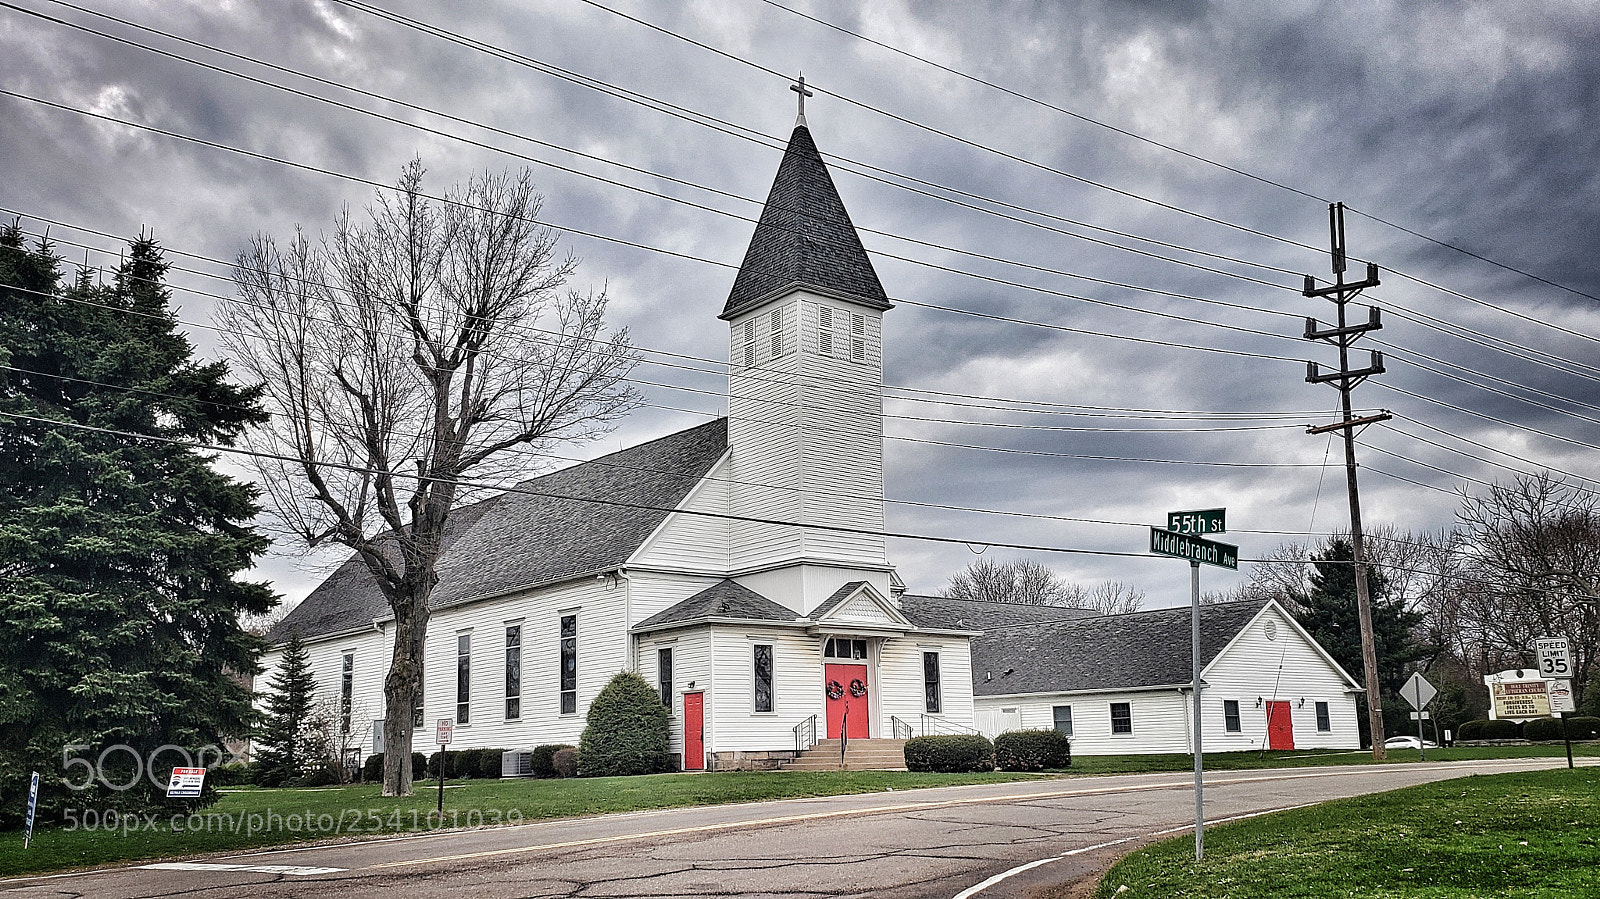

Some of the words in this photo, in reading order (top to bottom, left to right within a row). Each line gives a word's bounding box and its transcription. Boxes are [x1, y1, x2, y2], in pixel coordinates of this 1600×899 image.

[1172, 515, 1206, 533] 55th
[1211, 519, 1222, 531] St
[1153, 531, 1218, 562] Middlebranch
[1223, 552, 1235, 566] Ave
[1543, 659, 1568, 673] 35
